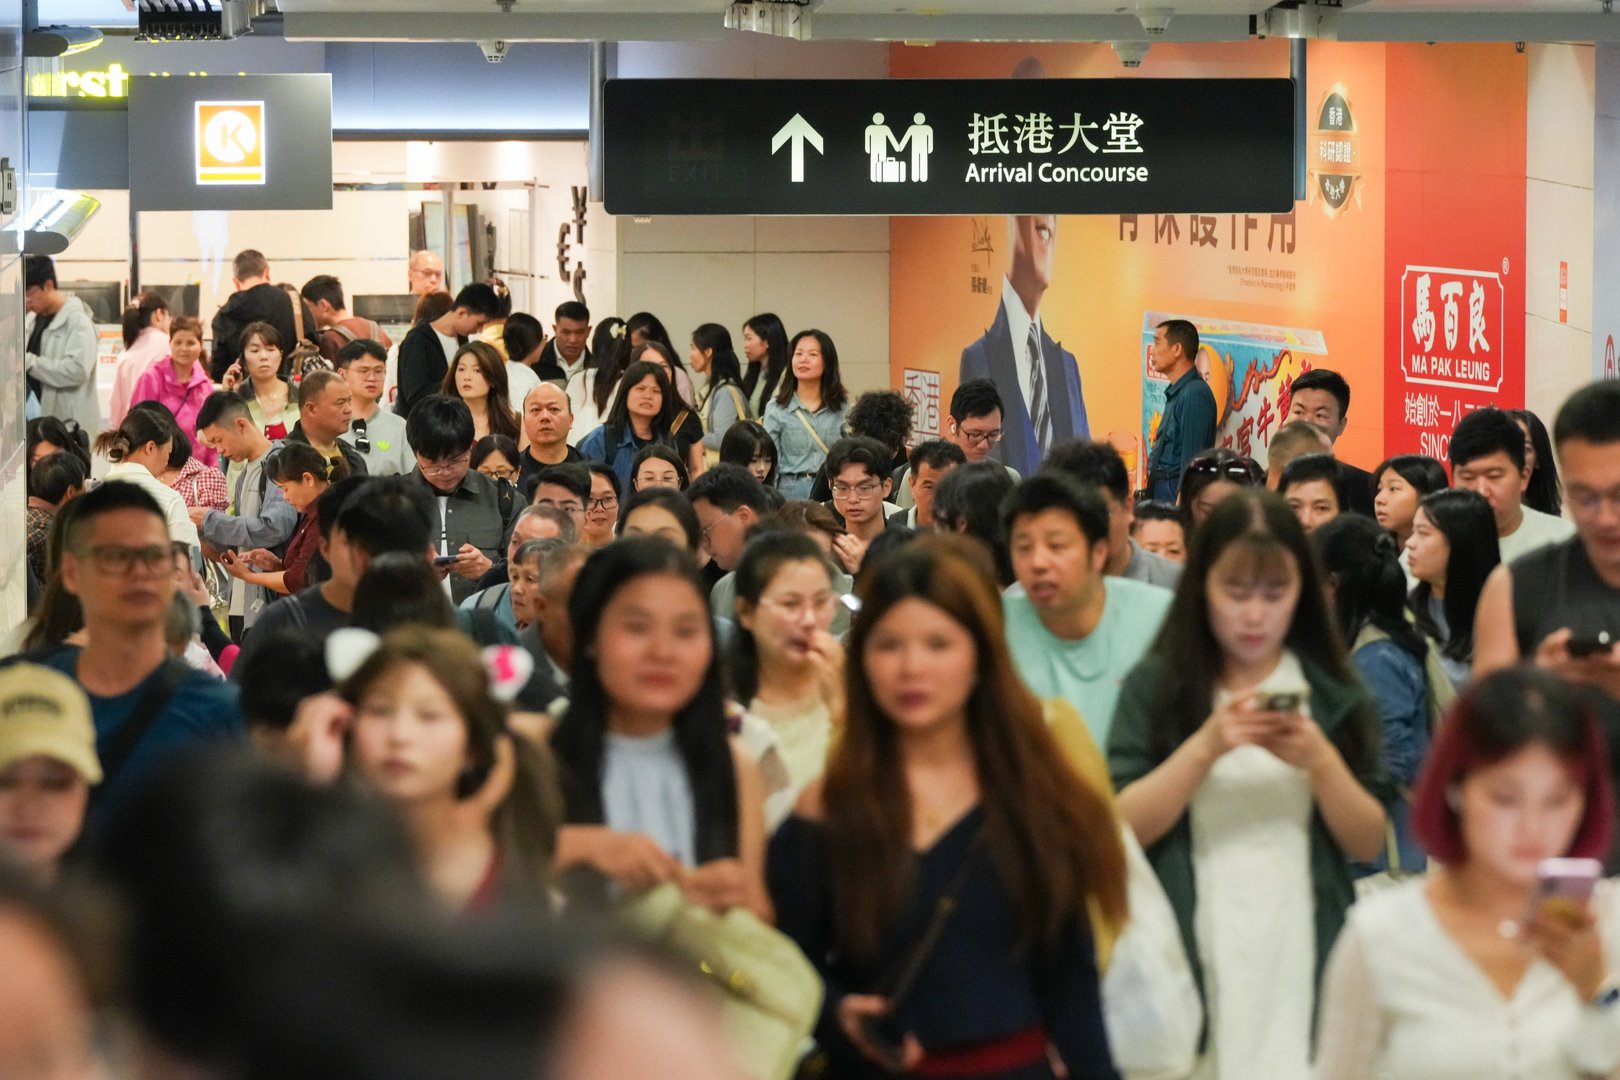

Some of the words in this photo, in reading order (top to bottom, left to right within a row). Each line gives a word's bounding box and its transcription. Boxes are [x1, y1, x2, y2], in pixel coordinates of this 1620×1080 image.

[26, 63, 129, 97] rst
[967, 111, 1144, 155] 抵港大堂
[965, 161, 1033, 183] Arrival
[1038, 162, 1149, 183] Concourse
[1412, 273, 1490, 354] 馬百良
[1411, 354, 1428, 374] MA
[1431, 356, 1452, 377] PAK
[1455, 359, 1490, 381] LEUNG
[1420, 431, 1453, 462] SINC
